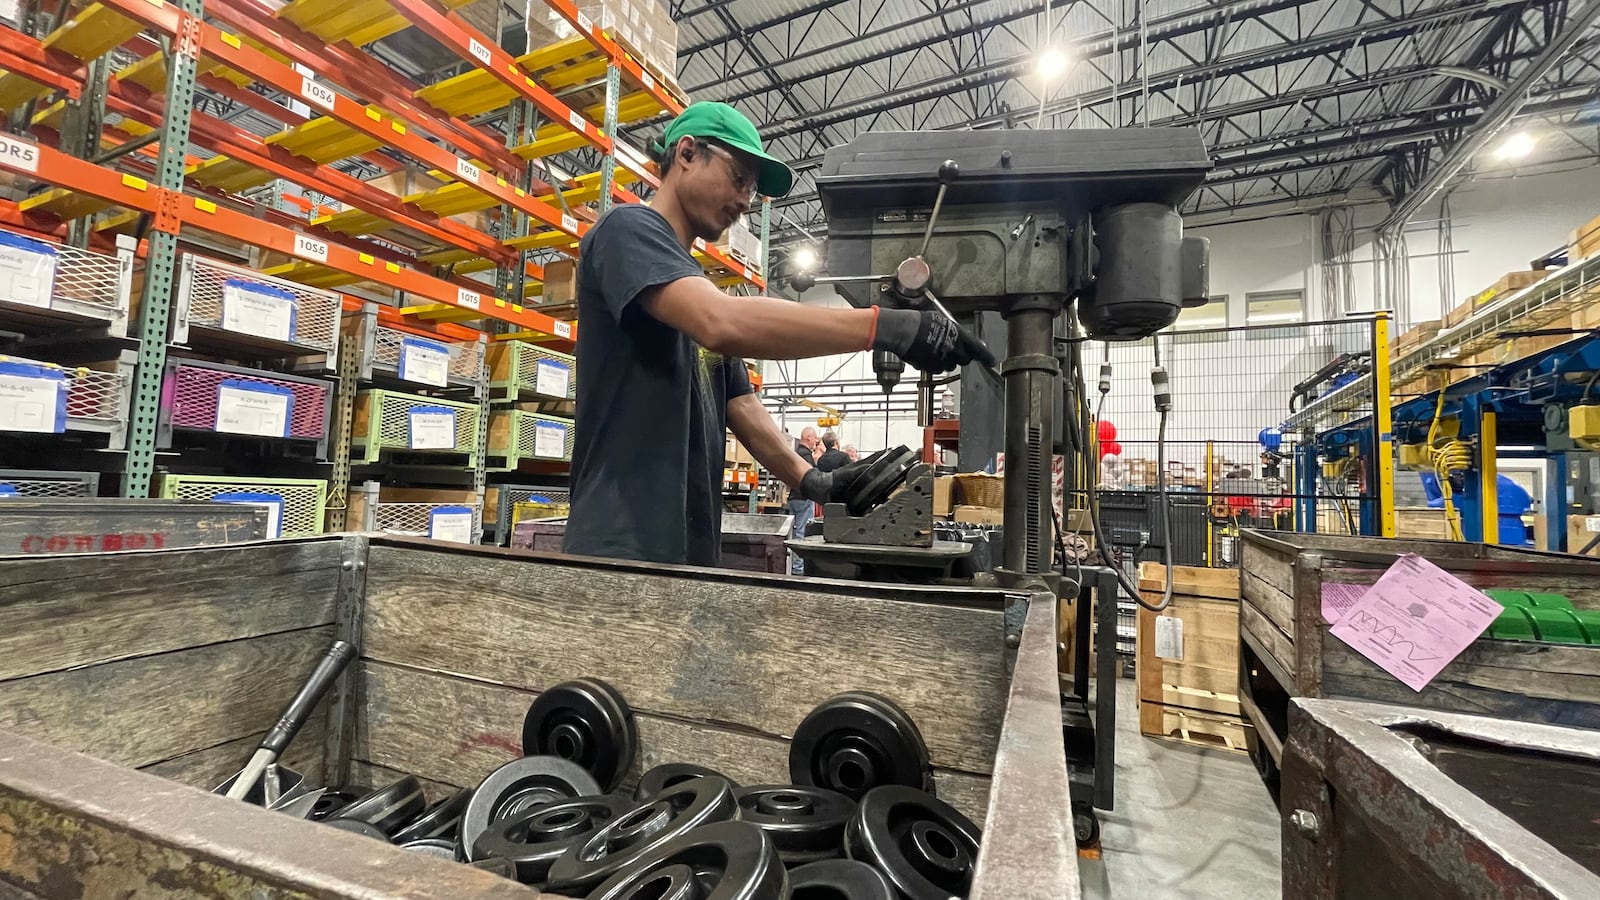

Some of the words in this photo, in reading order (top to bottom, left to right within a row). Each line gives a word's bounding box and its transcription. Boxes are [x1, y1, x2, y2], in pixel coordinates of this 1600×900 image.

[473, 42, 489, 59] 10T7
[306, 82, 333, 103] 10S6
[460, 162, 477, 178] 10T6
[299, 239, 326, 255] 10S5
[461, 292, 478, 304] 10T5
[555, 323, 570, 334] 10U5
